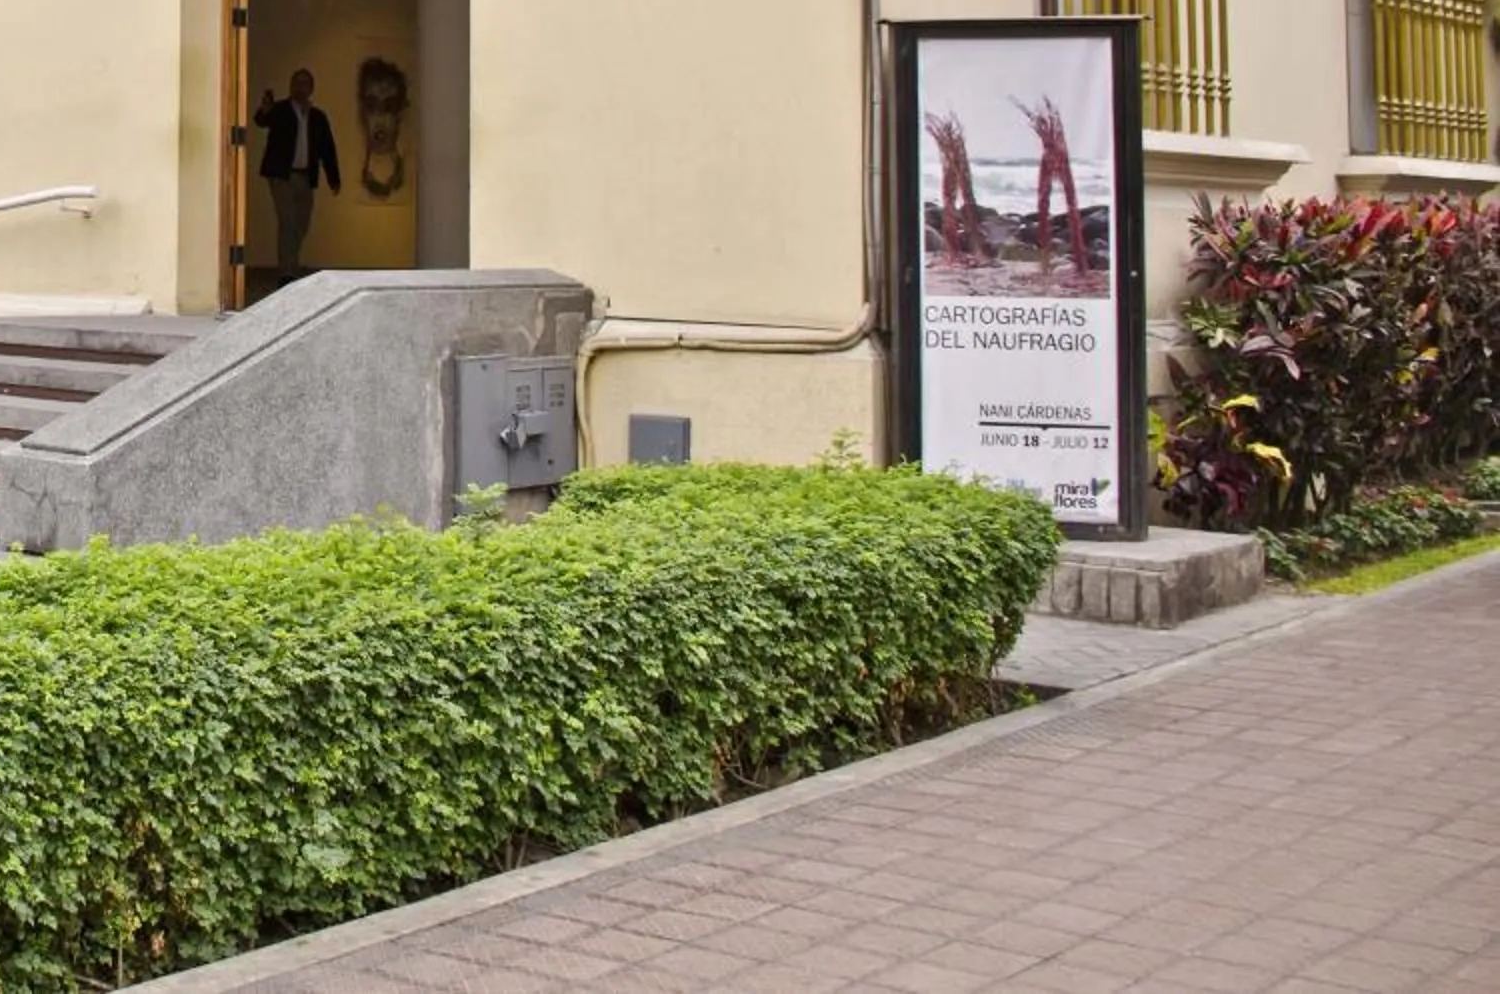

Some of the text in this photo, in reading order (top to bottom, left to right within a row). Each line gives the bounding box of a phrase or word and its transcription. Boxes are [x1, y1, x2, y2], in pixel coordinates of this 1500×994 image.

[925, 303, 1086, 327] CARTOGRAFÍAS
[925, 330, 1096, 353] DEL NAUFRAGIO
[979, 400, 1092, 421] NANI CÁRDENAS
[981, 433, 1019, 447] JUNIO
[1023, 434, 1040, 447] 18
[1052, 435, 1088, 449] JULIO
[1093, 437, 1109, 449] 12
[1054, 481, 1090, 496] mira
[1053, 494, 1098, 509] flores
